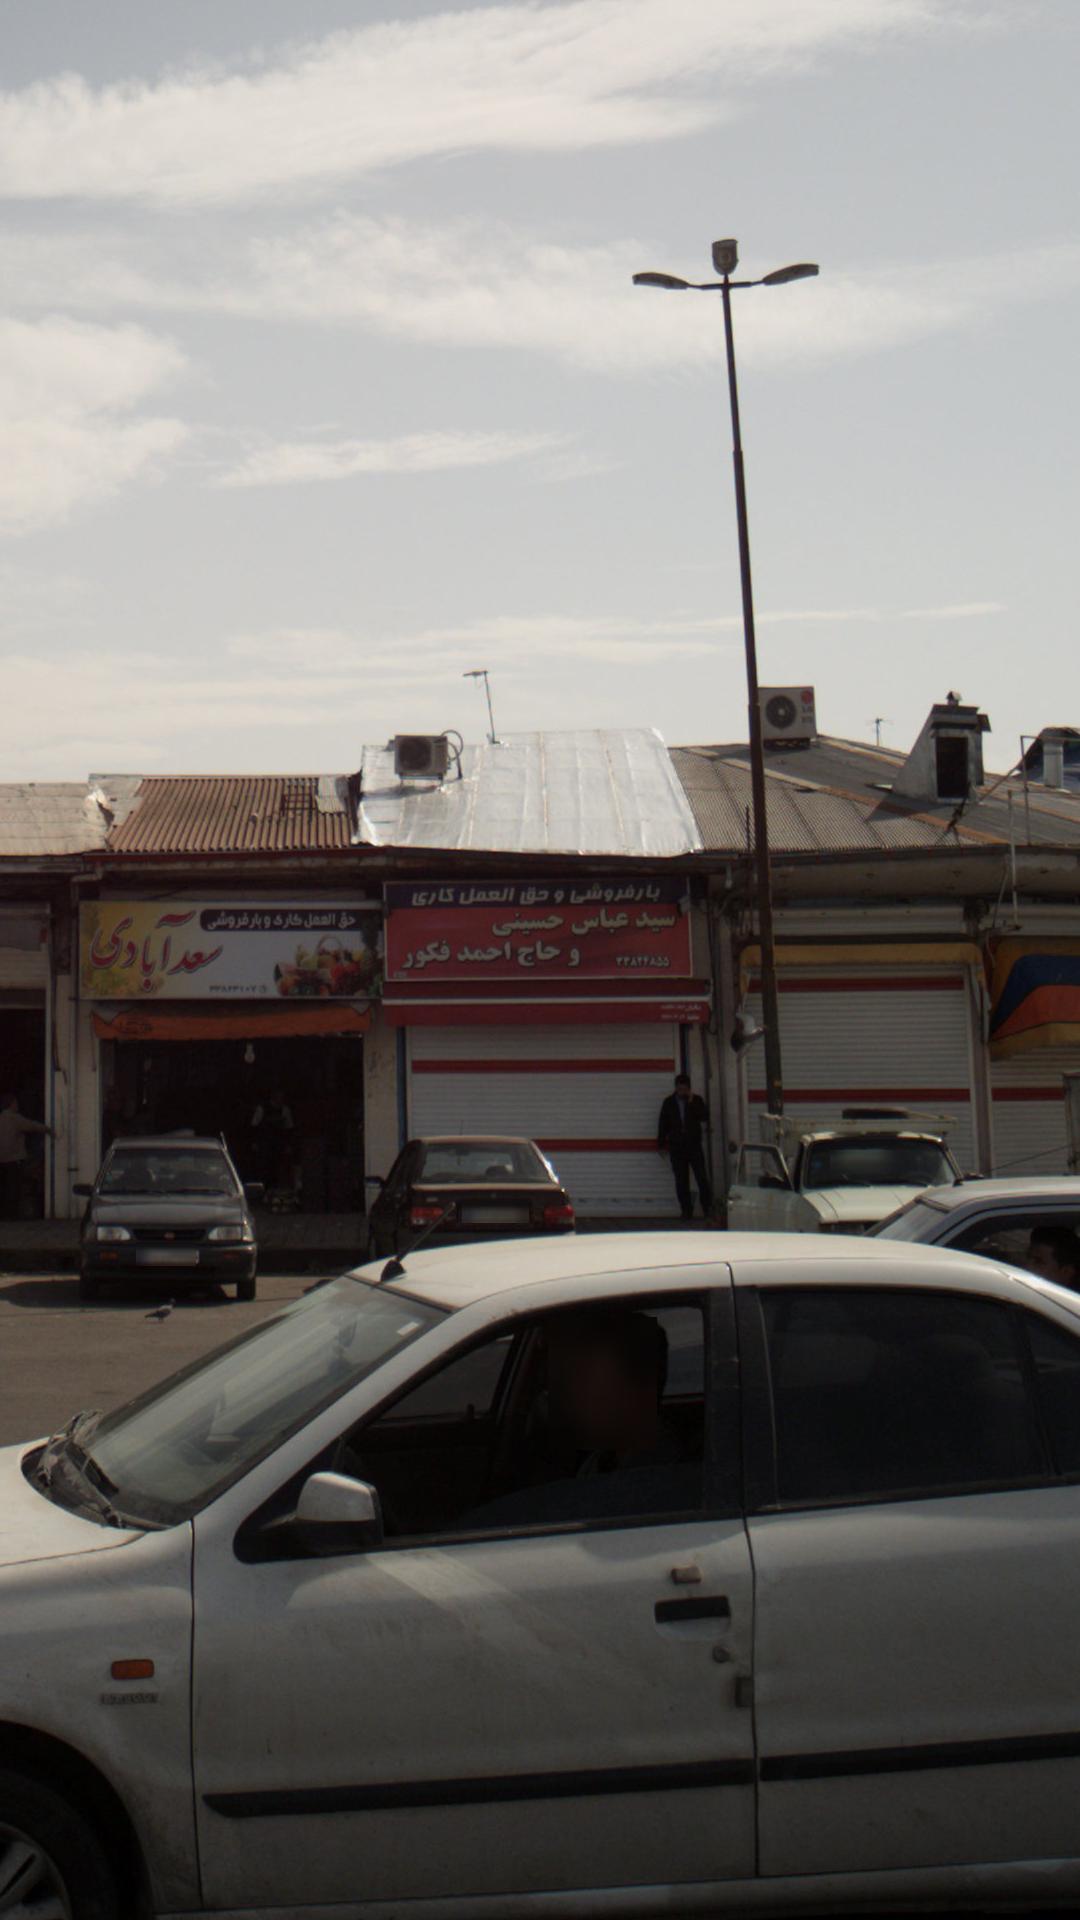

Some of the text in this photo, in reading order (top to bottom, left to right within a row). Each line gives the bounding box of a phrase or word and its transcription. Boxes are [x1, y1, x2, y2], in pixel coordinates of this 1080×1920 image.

[411, 883, 660, 906] بارفروشی و حق العمل کاری
[263, 914, 272, 928] و
[273, 912, 302, 929] کاری
[304, 912, 336, 928] العمل
[338, 911, 357, 929] حق
[492, 907, 676, 936] سید عباس حسینی
[401, 940, 581, 969] و حاج احمد فکور
